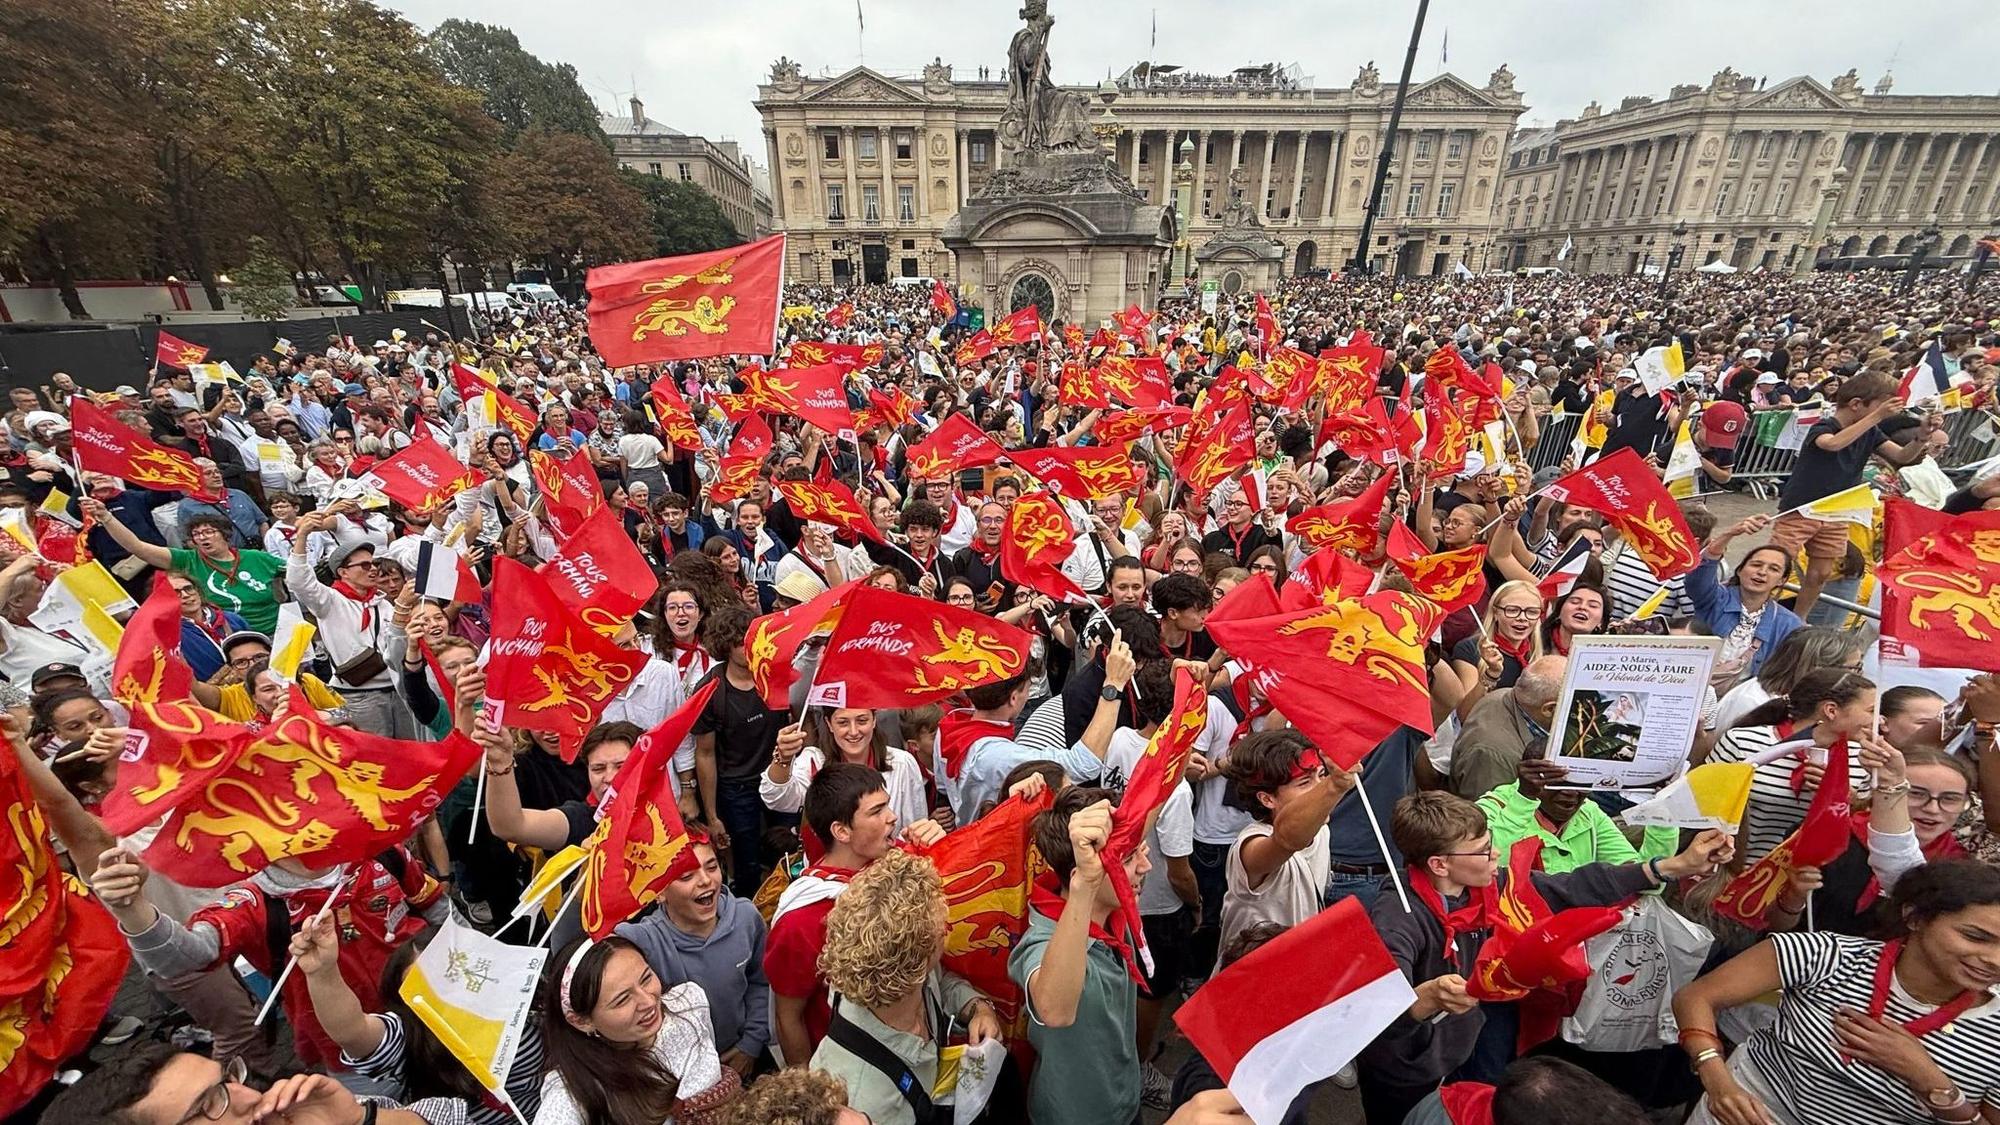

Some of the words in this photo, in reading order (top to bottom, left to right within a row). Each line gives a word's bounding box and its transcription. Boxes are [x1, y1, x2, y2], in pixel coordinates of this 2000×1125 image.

[88, 426, 114, 442] TOUS
[1583, 470, 1629, 510] NORMANDS
[1605, 475, 1632, 497] TOUS
[573, 551, 608, 584] TOUS
[520, 616, 547, 640] TOUS
[867, 620, 903, 636] TOUS
[838, 635, 914, 656] NORMANDS
[1583, 663, 1651, 673] AIDEZ-NOUS
[1652, 662, 1661, 673] À
[1663, 665, 1695, 674] FAIRE
[1631, 656, 1659, 664] Marie,
[1593, 672, 1603, 681] la
[1605, 672, 1642, 682] Volonté
[1643, 673, 1657, 682] de
[1658, 674, 1686, 684] Dieu
